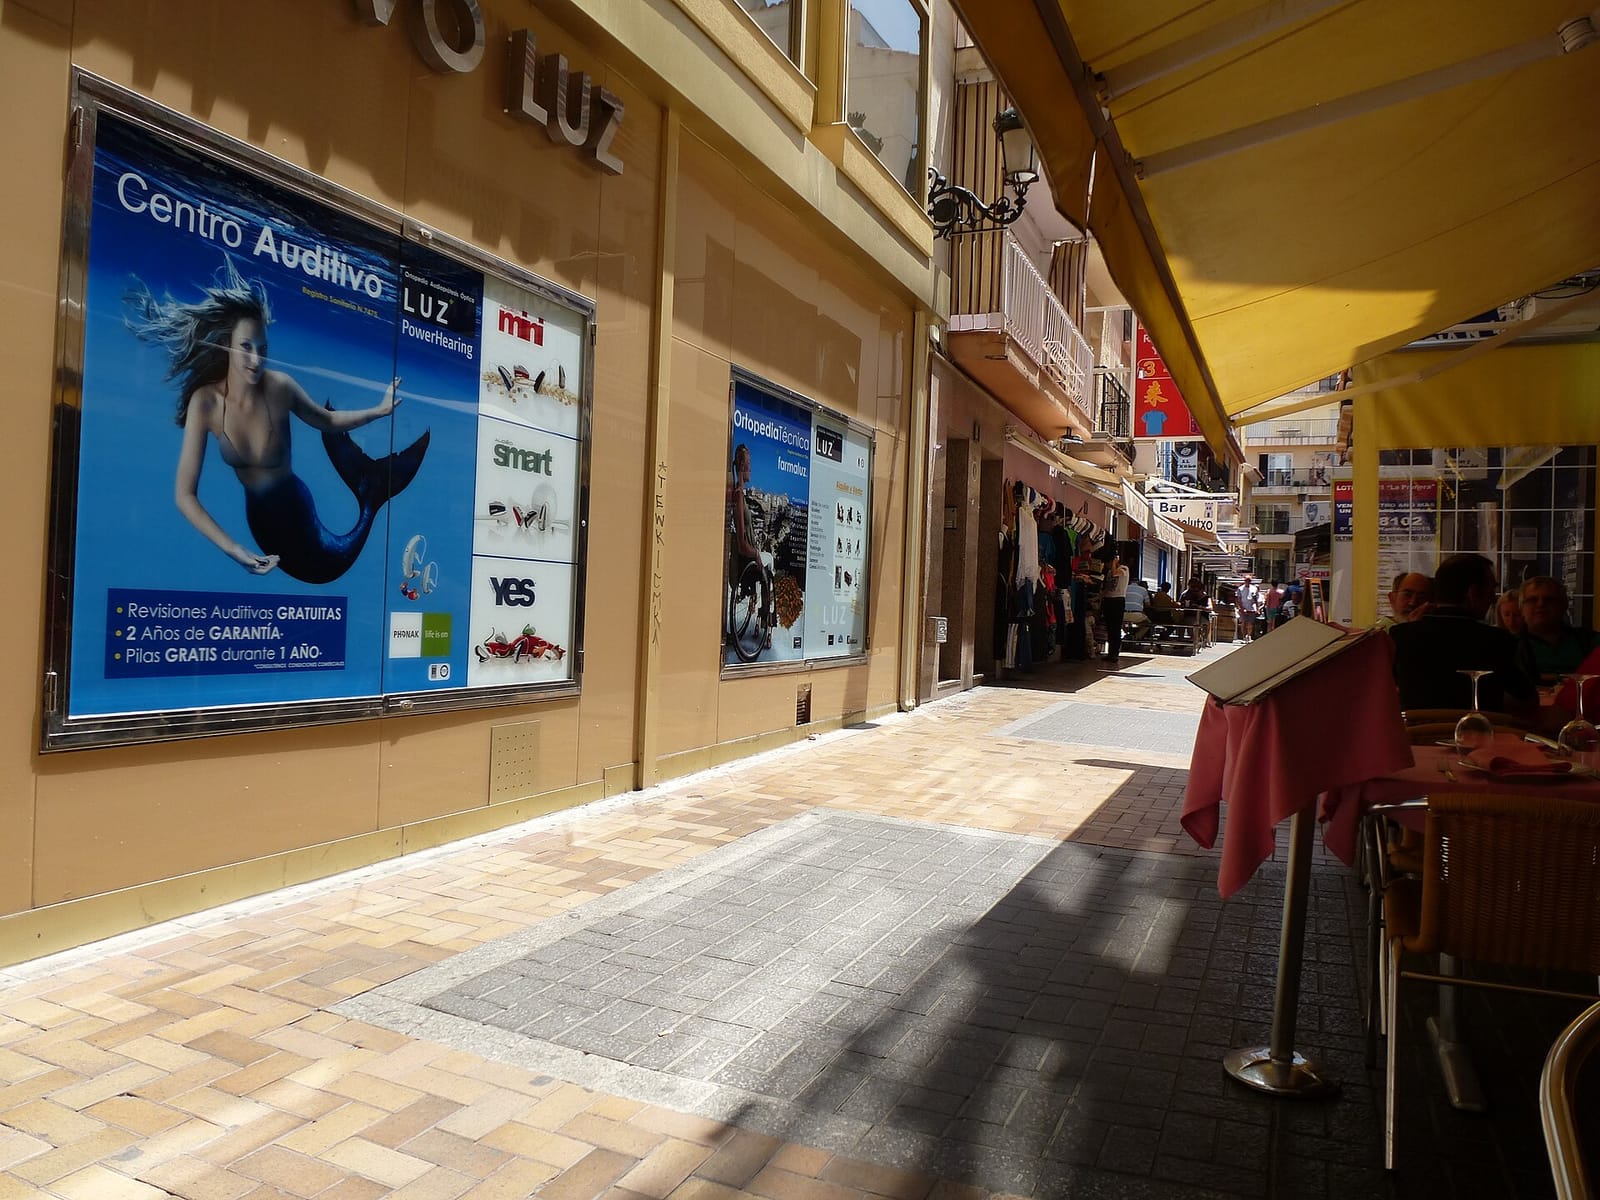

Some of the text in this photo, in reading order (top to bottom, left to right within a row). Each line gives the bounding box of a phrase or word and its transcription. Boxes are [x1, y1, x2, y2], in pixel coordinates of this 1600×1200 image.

[512, 28, 624, 175] LUZ
[117, 172, 383, 299] Centro Auditivo
[403, 287, 448, 325] LUZ
[498, 309, 544, 347] mini
[401, 318, 473, 360] PowerHearing
[816, 437, 833, 457] LUZ
[493, 443, 552, 476] smart
[1159, 503, 1186, 513] Bar
[127, 603, 342, 621] Revisiones Auditivas GRATUITAS
[823, 604, 846, 625] LUZ
[126, 626, 136, 641] 2
[141, 625, 180, 641] Años
[184, 625, 205, 641] de
[393, 630, 419, 639] PHONAK
[126, 648, 160, 663] Pilas
[164, 647, 217, 663] GRATIS
[221, 647, 275, 661] durante
[279, 646, 286, 659] 1
